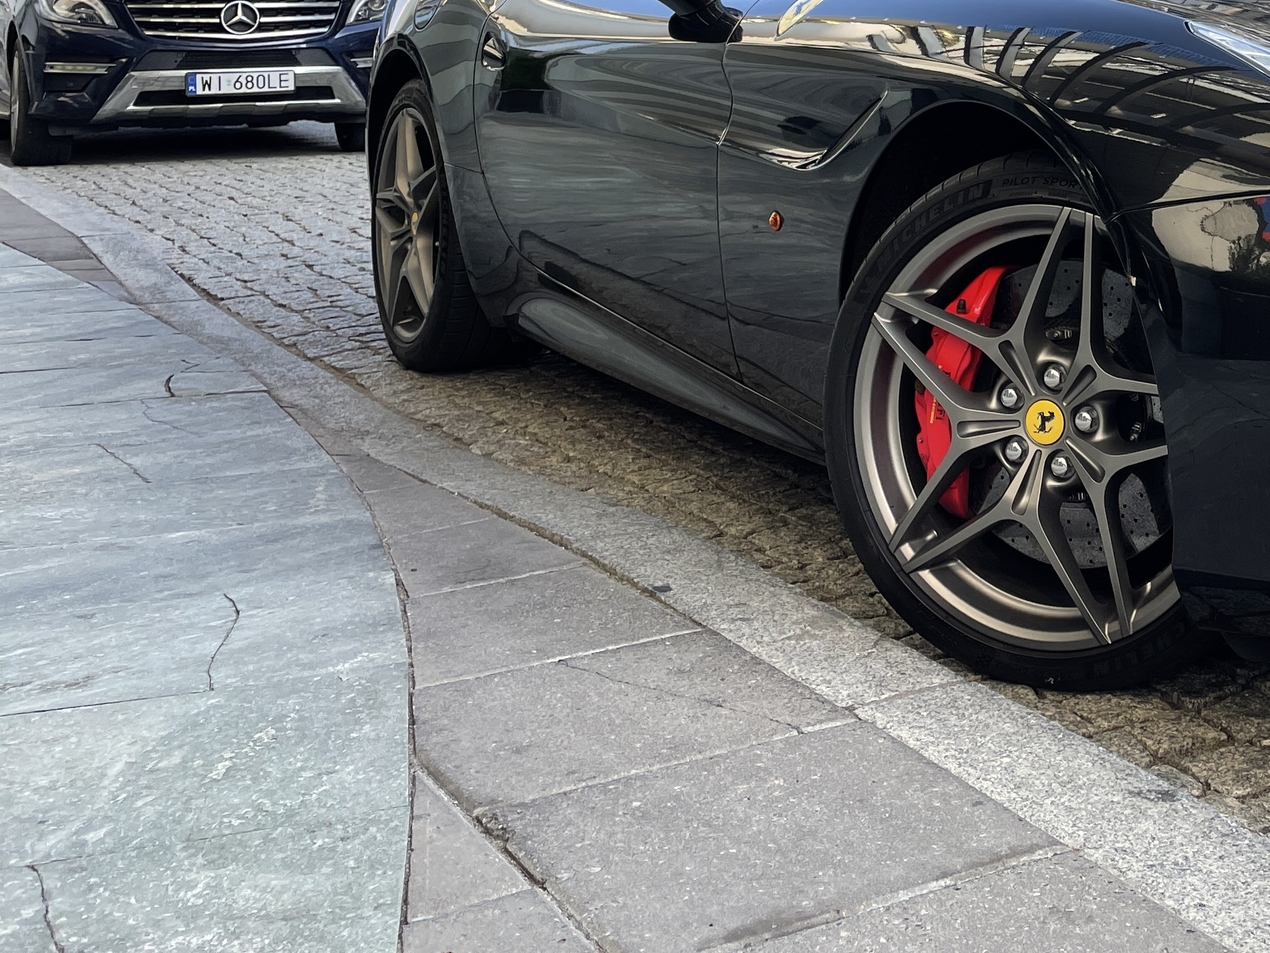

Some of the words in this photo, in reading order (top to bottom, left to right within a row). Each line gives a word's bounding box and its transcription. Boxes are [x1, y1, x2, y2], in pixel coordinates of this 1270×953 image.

[201, 75, 222, 91] WI
[233, 73, 289, 90] 680LE
[1002, 176, 1038, 187] PILOT
[876, 183, 986, 272] MICHELIN
